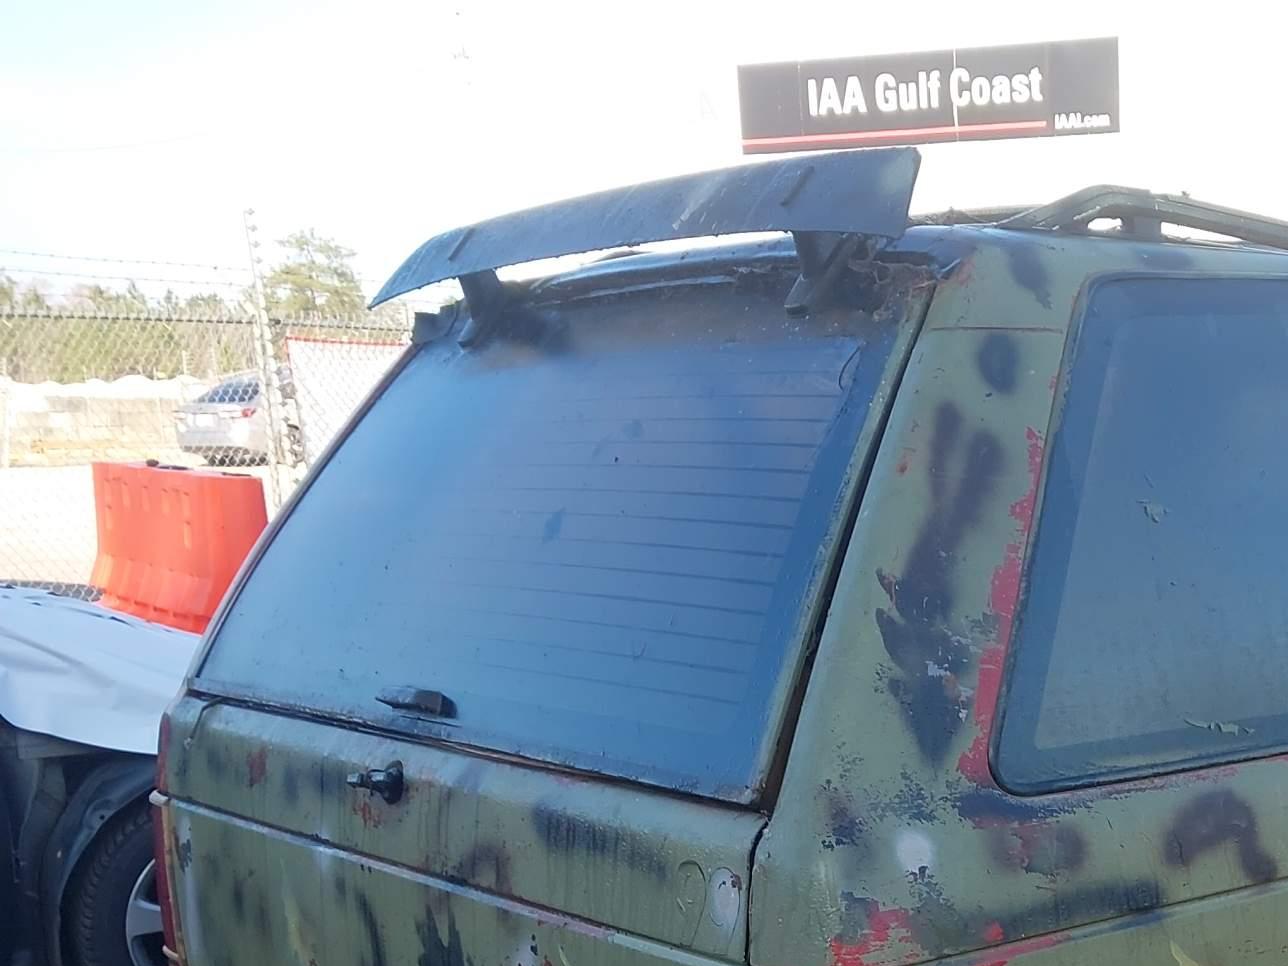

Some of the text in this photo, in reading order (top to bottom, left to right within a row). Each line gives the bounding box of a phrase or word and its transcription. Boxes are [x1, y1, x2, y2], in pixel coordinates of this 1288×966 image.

[808, 66, 1043, 116] IAA Gulf Coast
